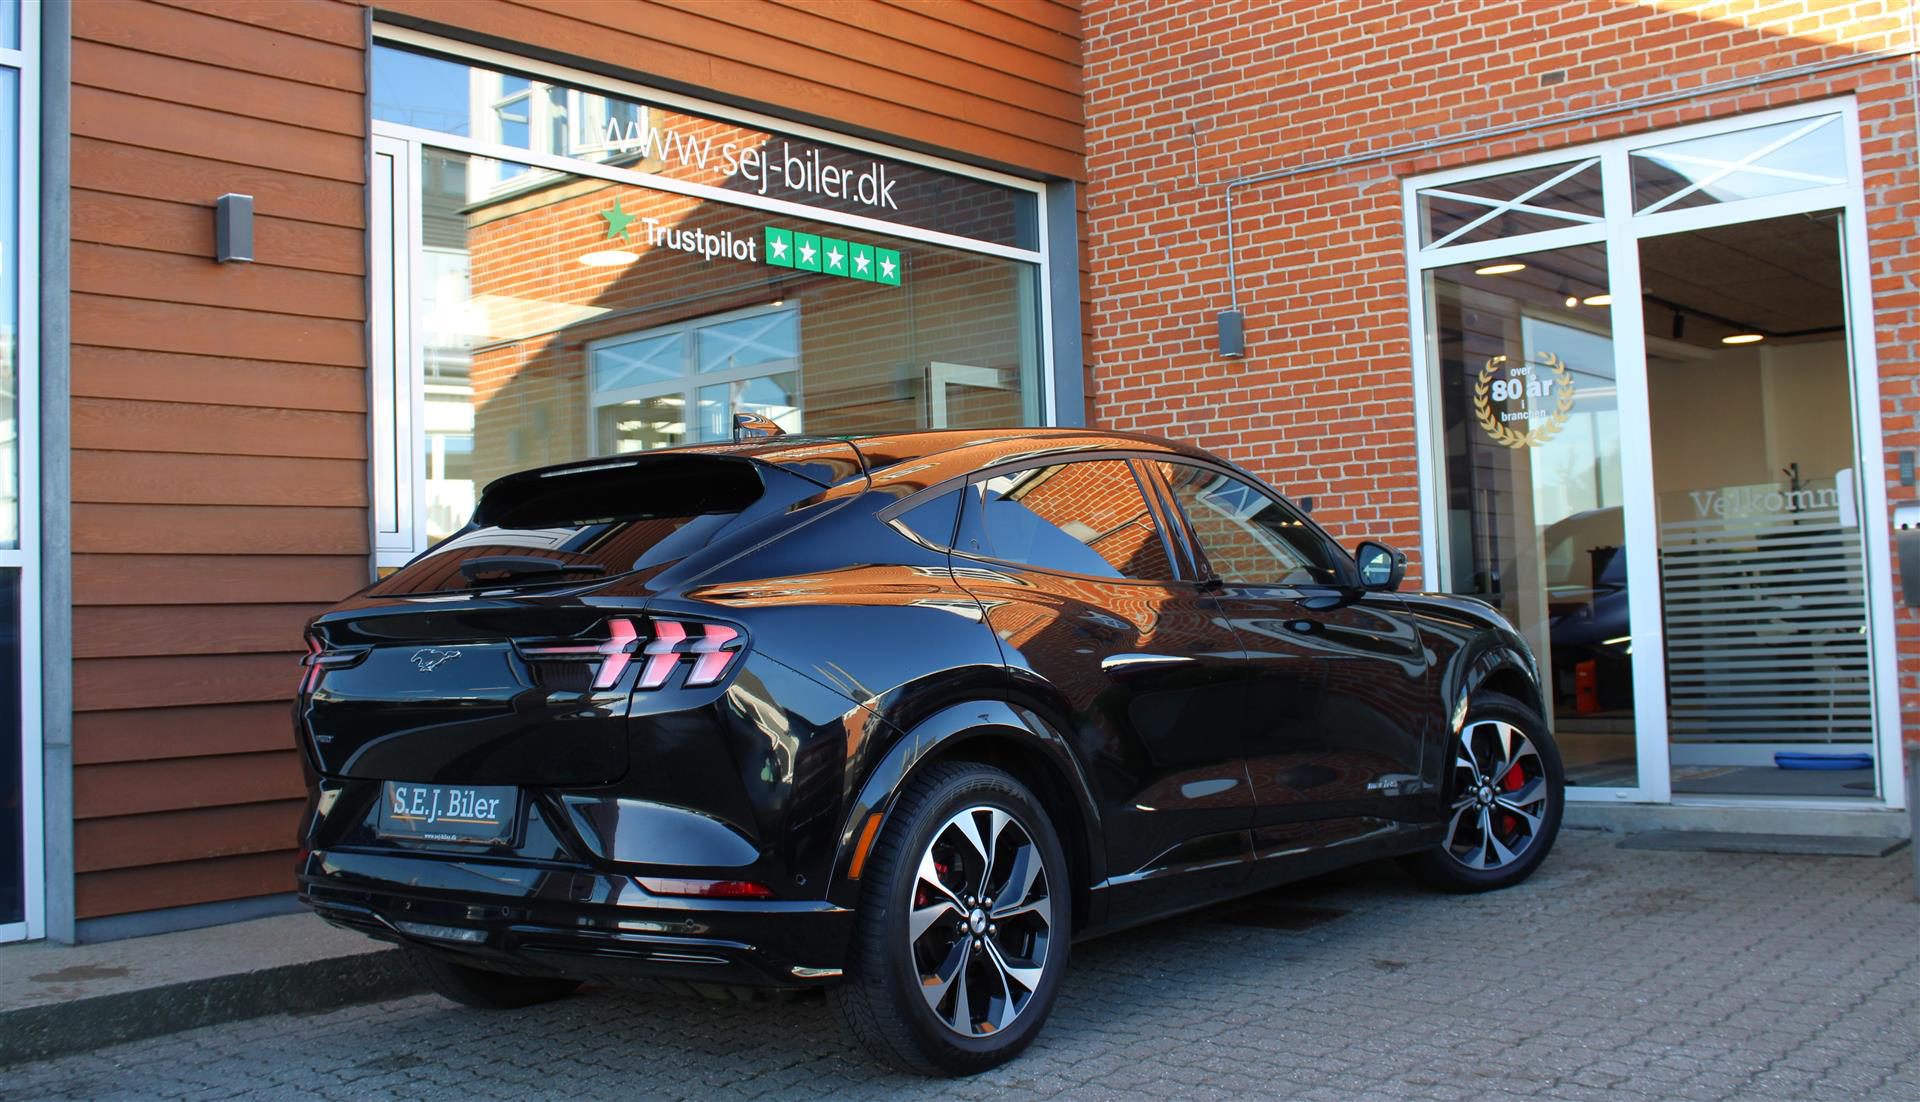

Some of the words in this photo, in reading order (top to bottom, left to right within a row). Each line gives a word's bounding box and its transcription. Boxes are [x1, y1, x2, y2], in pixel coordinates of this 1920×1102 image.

[597, 114, 899, 210] www.sej-biler.dk
[641, 217, 757, 262] Trustpilot
[1510, 366, 1532, 377] over
[1491, 378, 1523, 402] 80
[1526, 374, 1553, 397] år
[1501, 409, 1546, 422] branchen
[394, 787, 442, 823] S.E.J.
[446, 789, 500, 819] Biler
